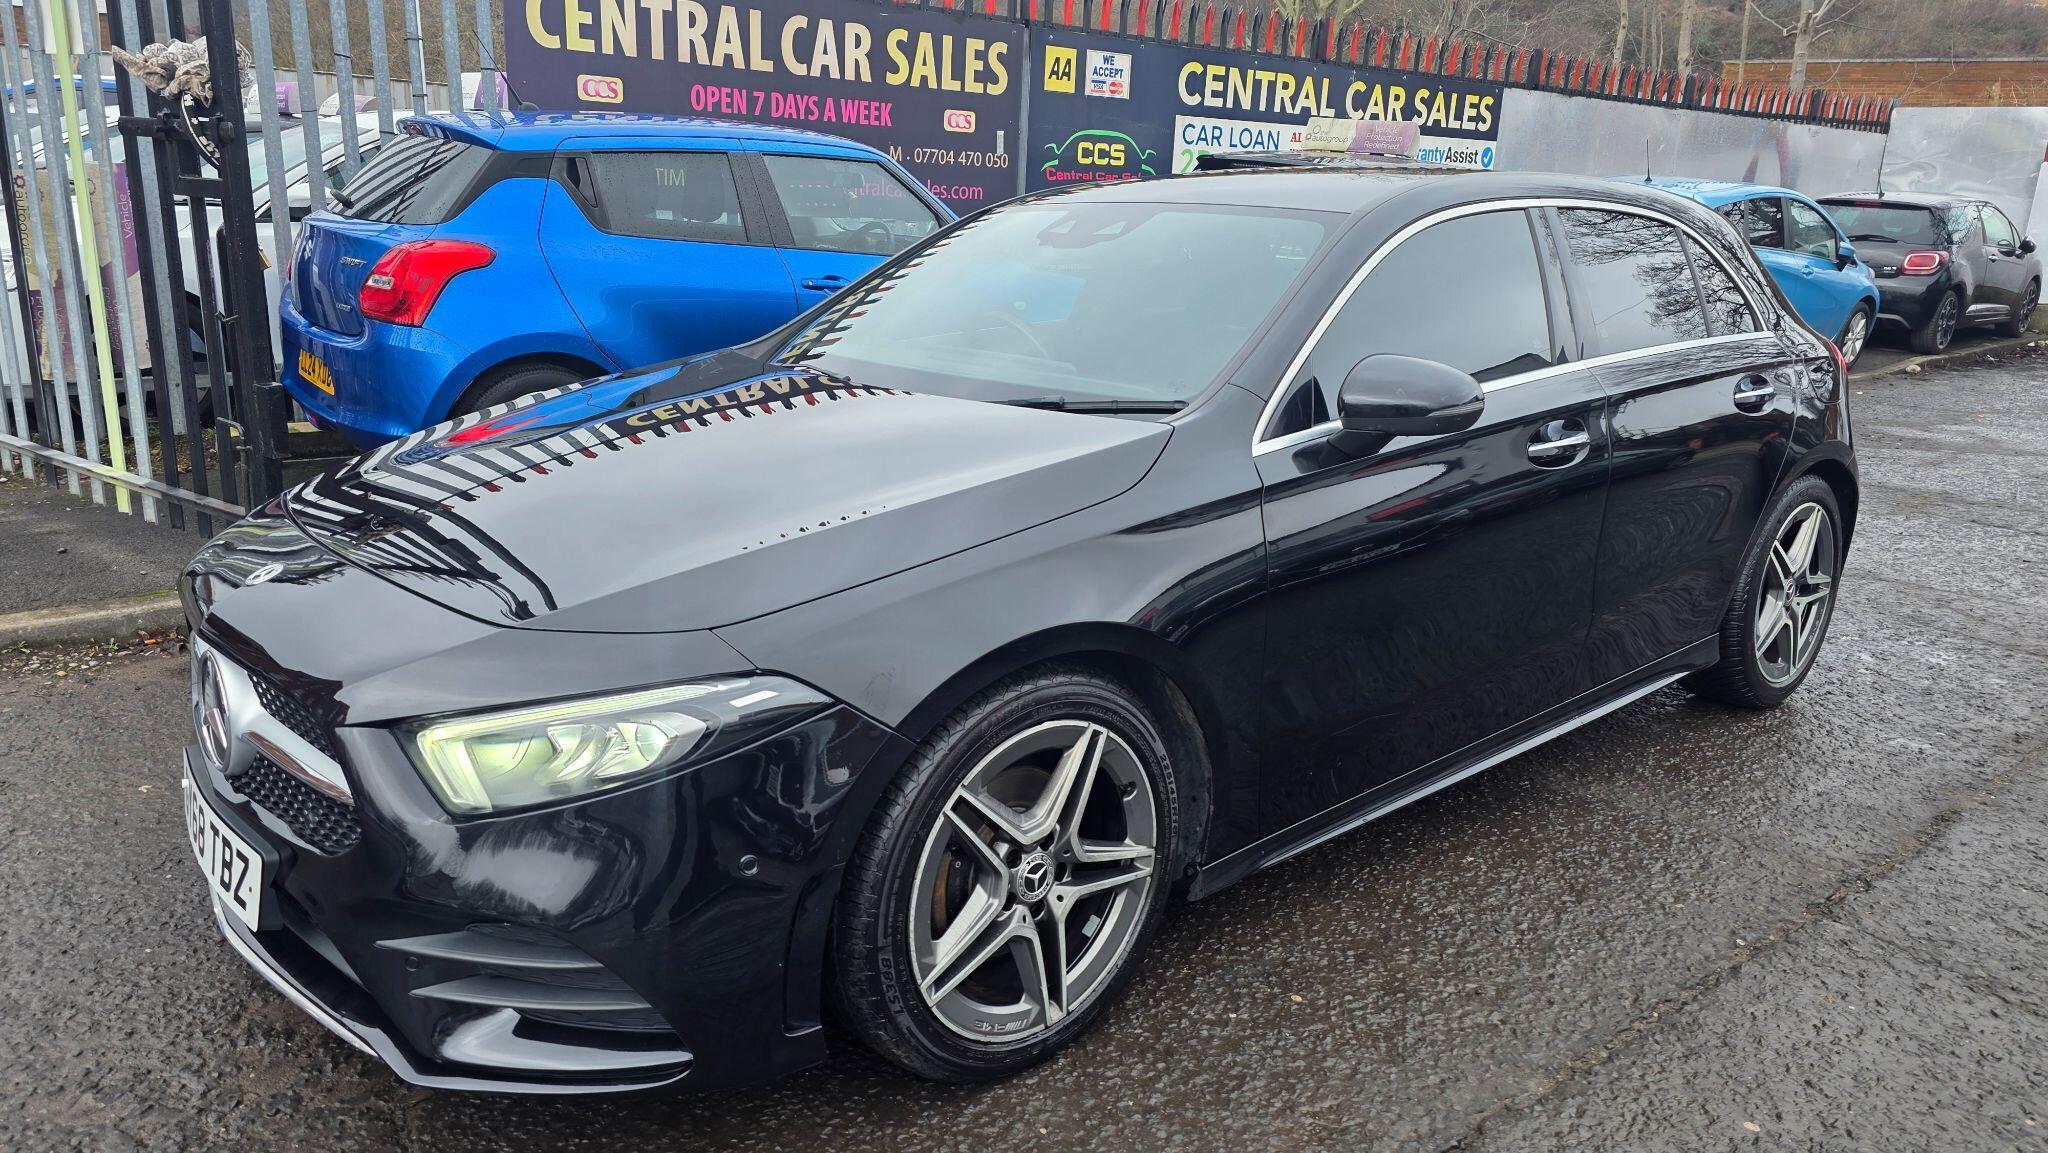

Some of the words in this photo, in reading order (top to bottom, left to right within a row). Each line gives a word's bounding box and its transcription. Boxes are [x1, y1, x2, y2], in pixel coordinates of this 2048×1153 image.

[526, 0, 774, 72] CENTRAL
[781, 15, 872, 83] CAR
[886, 28, 1009, 96] SALES
[1102, 54, 1115, 66] WE
[1048, 57, 1072, 81] AA
[1092, 66, 1124, 79] ACCEPT
[582, 78, 619, 100] CCS
[1178, 61, 1335, 117] CENTRAL
[1346, 81, 1405, 119] CAR
[1413, 88, 1494, 132] SALES
[691, 84, 747, 115] OPEN
[752, 91, 765, 116] 7
[770, 92, 819, 121] DAYS
[823, 97, 836, 122] A
[840, 98, 893, 127] WEEK
[1182, 123, 1223, 146] CAR
[1229, 127, 1280, 150] LOAN
[914, 148, 954, 165] 07704
[958, 151, 984, 167] 470
[986, 152, 1009, 169] 050
[1077, 142, 1125, 166] CCS
[1046, 166, 1092, 181] Central
[210, 820, 250, 911] TBZ
